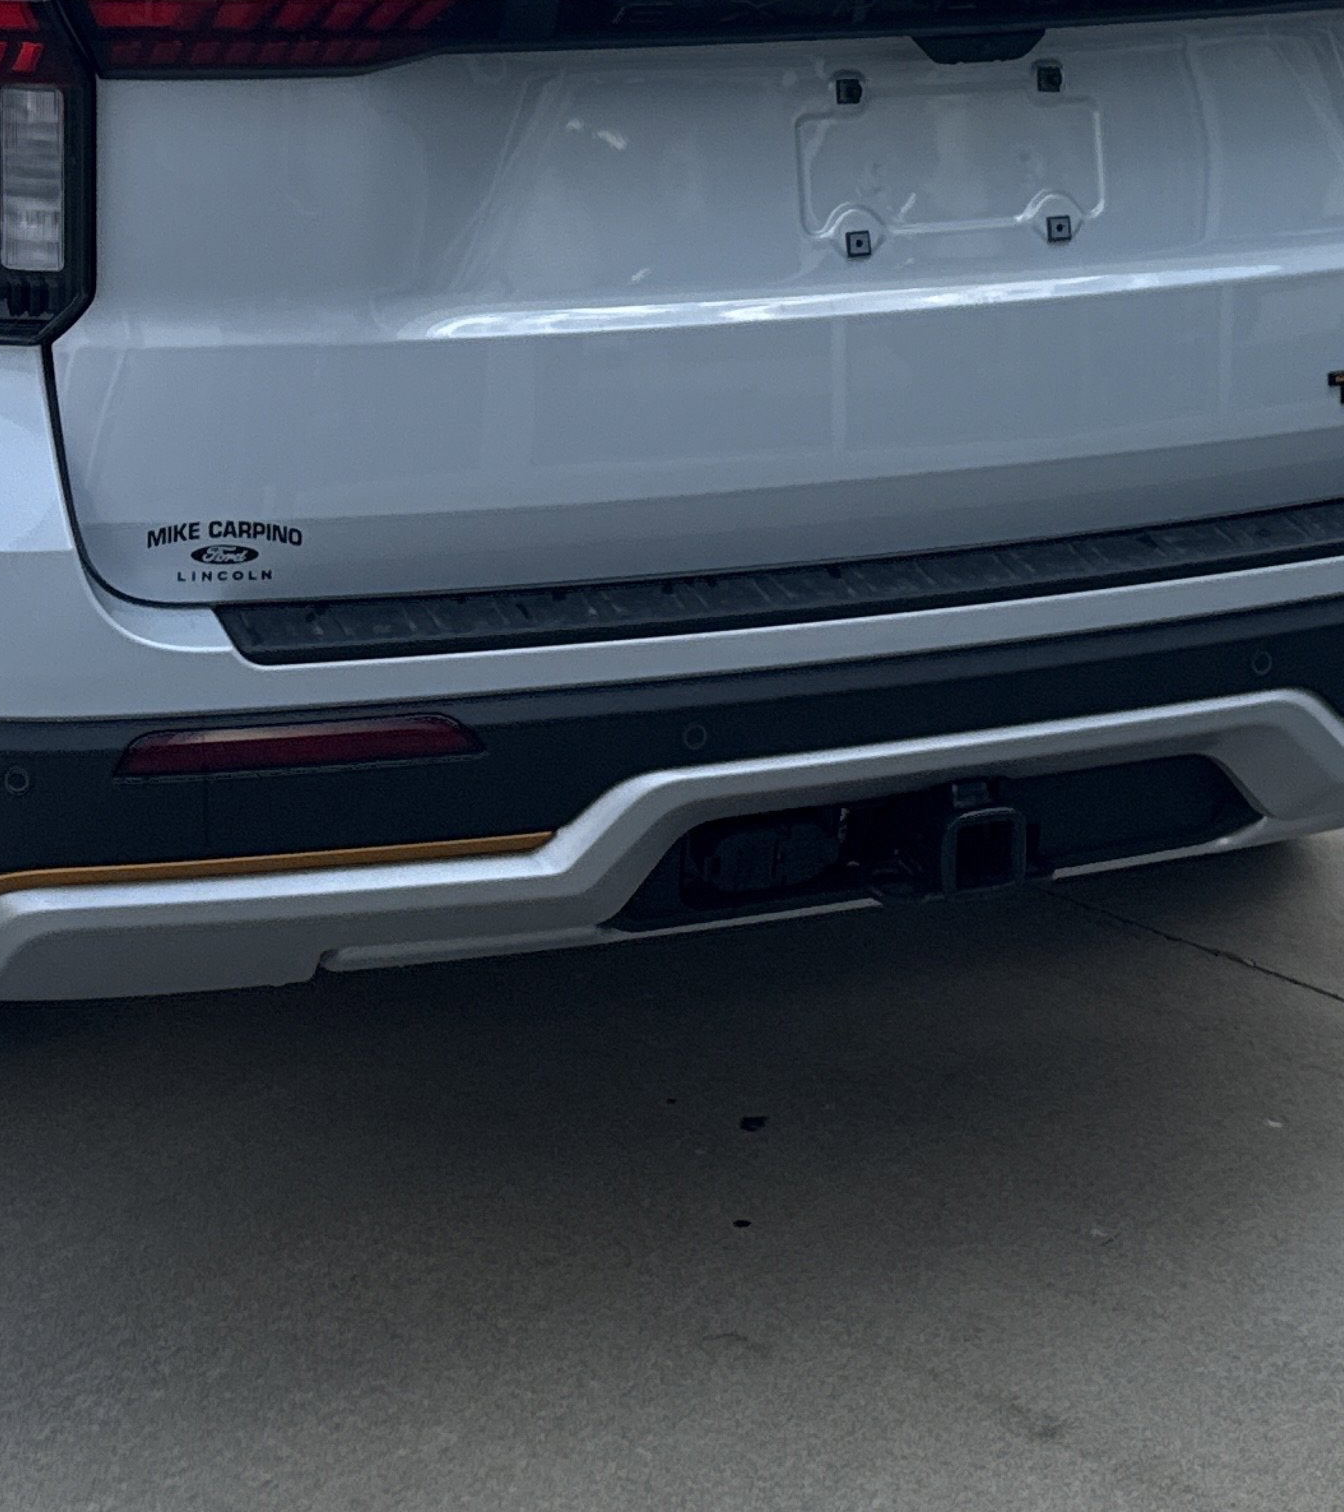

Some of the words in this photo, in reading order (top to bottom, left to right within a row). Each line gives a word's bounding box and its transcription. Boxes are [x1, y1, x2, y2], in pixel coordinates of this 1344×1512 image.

[146, 521, 201, 549] MIKE
[208, 520, 304, 547] CARPINO
[201, 544, 249, 563] Ford
[176, 569, 274, 583] LINCOLN
